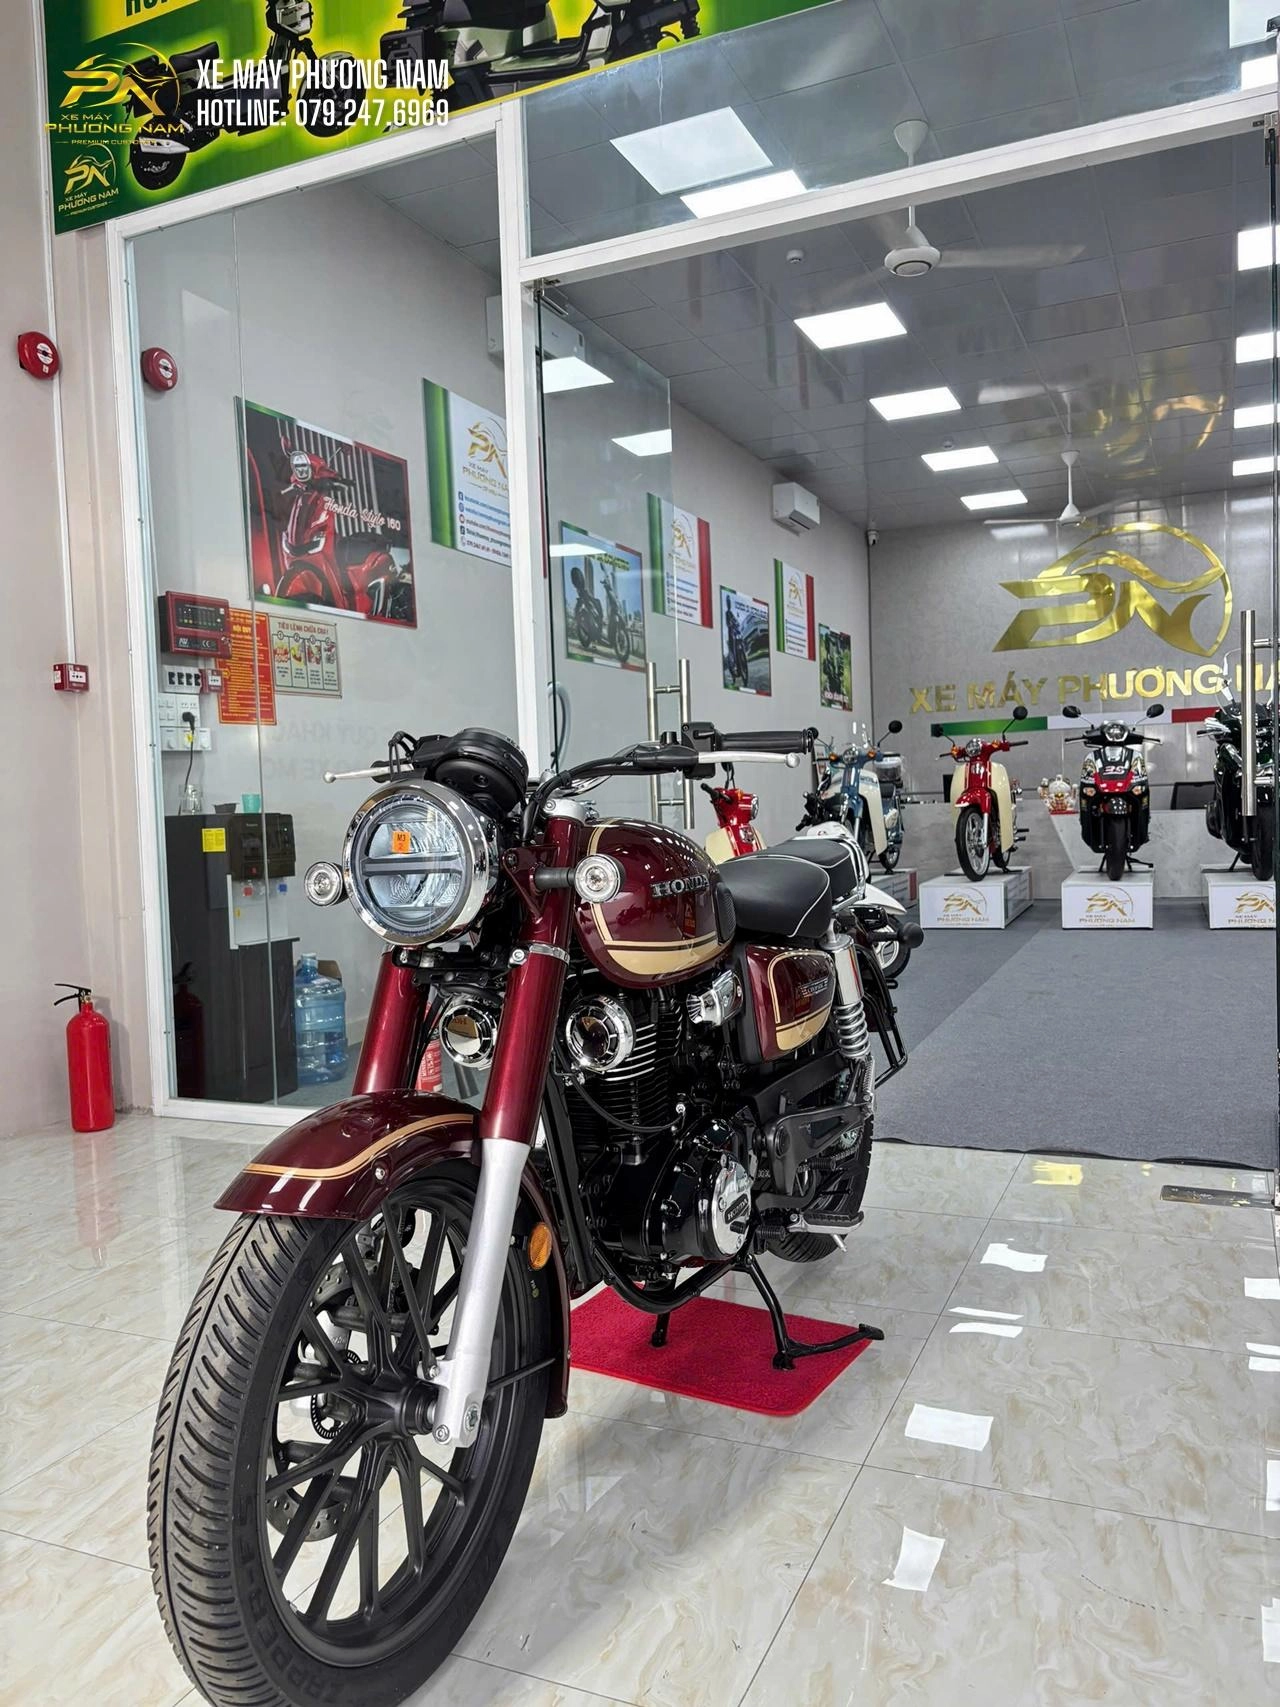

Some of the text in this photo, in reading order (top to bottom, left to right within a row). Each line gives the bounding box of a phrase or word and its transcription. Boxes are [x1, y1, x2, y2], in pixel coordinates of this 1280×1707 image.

[98, 187, 119, 200] NAM
[323, 496, 358, 518] Honda
[386, 517, 401, 531] 160
[909, 684, 956, 714] XE
[967, 670, 1048, 712] MÁY
[1057, 662, 1224, 704] PHƯƠNG
[650, 875, 710, 897] HONDA
